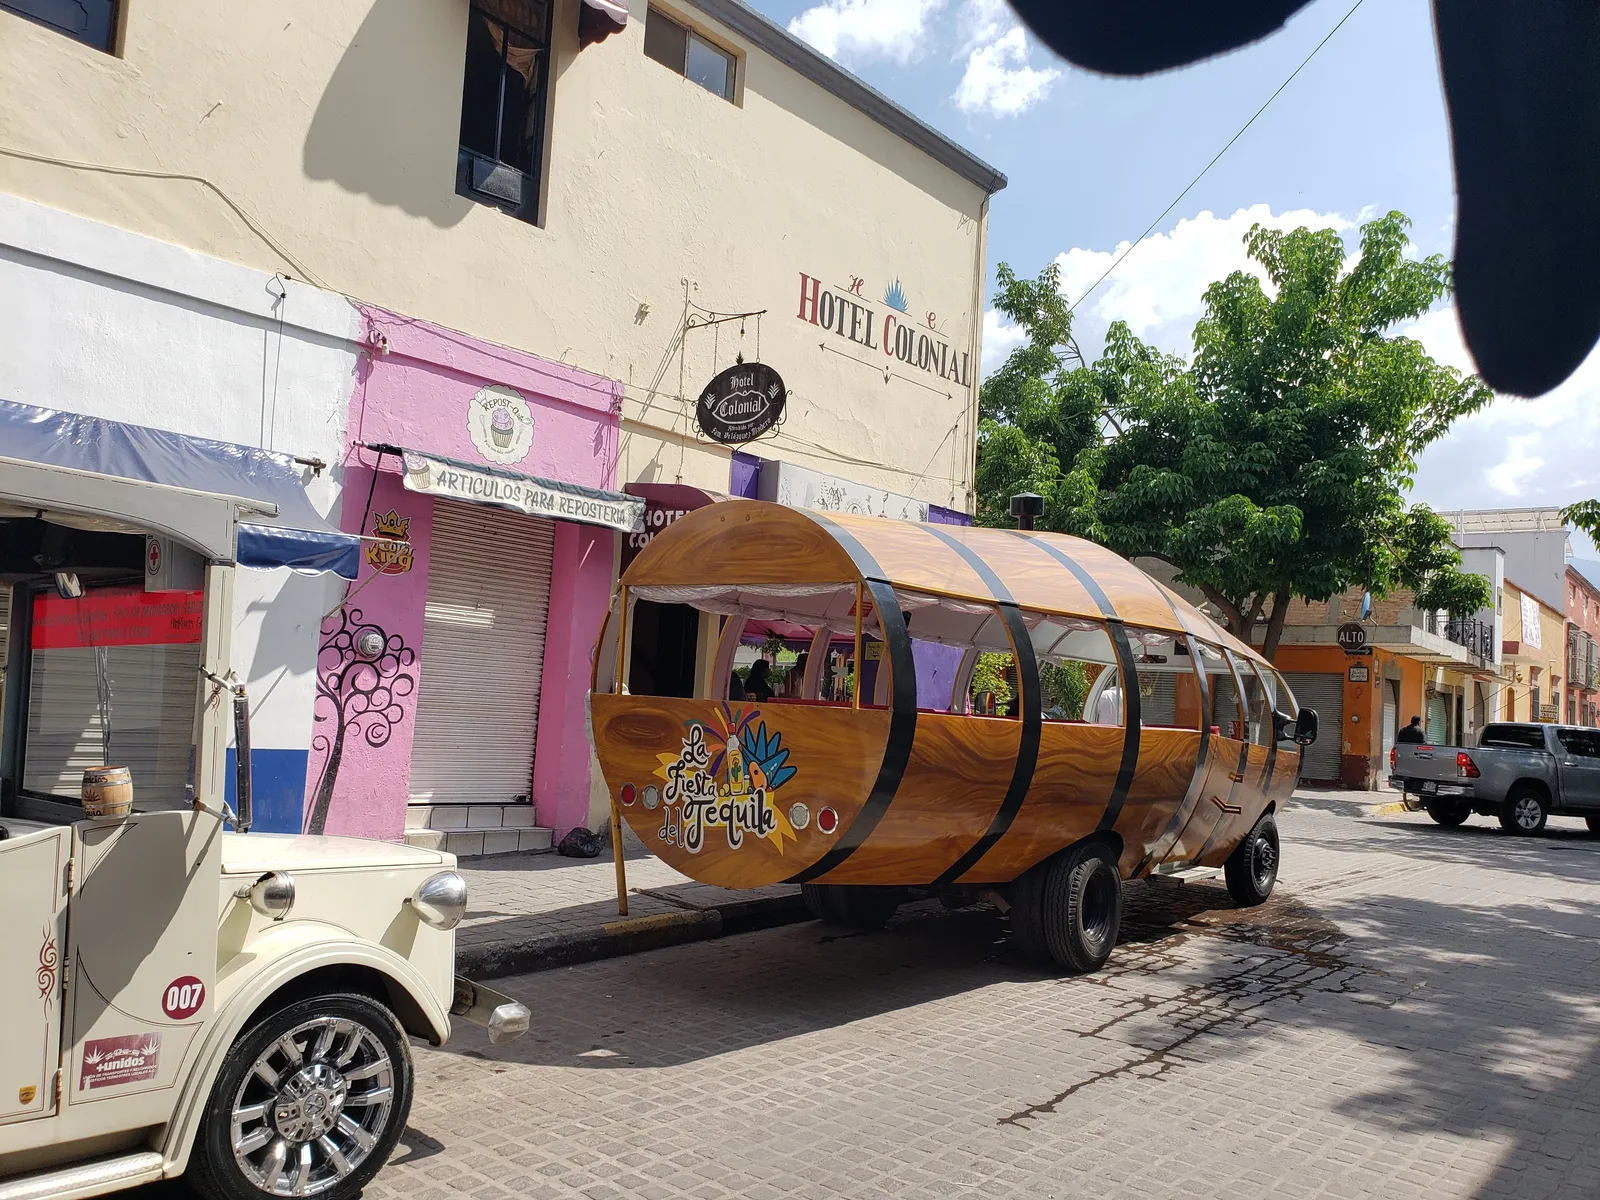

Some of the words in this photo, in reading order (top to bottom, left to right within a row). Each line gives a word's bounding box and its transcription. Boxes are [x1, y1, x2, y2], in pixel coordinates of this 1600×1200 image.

[797, 271, 878, 350] HOTEL
[883, 314, 971, 389] COLONIAL
[730, 373, 754, 390] Hotel
[719, 396, 762, 417] Colonial
[437, 470, 521, 502] ARTICULOS
[525, 488, 554, 511] PARA
[559, 496, 626, 524] REPOSTERIA
[646, 509, 691, 527] HOTE
[364, 547, 413, 572] King
[1339, 631, 1364, 643] ALTO
[682, 725, 711, 766] La
[665, 760, 717, 800] Fiesta
[658, 806, 684, 847] del
[684, 788, 777, 849] Tequila
[166, 983, 203, 1011] 007
